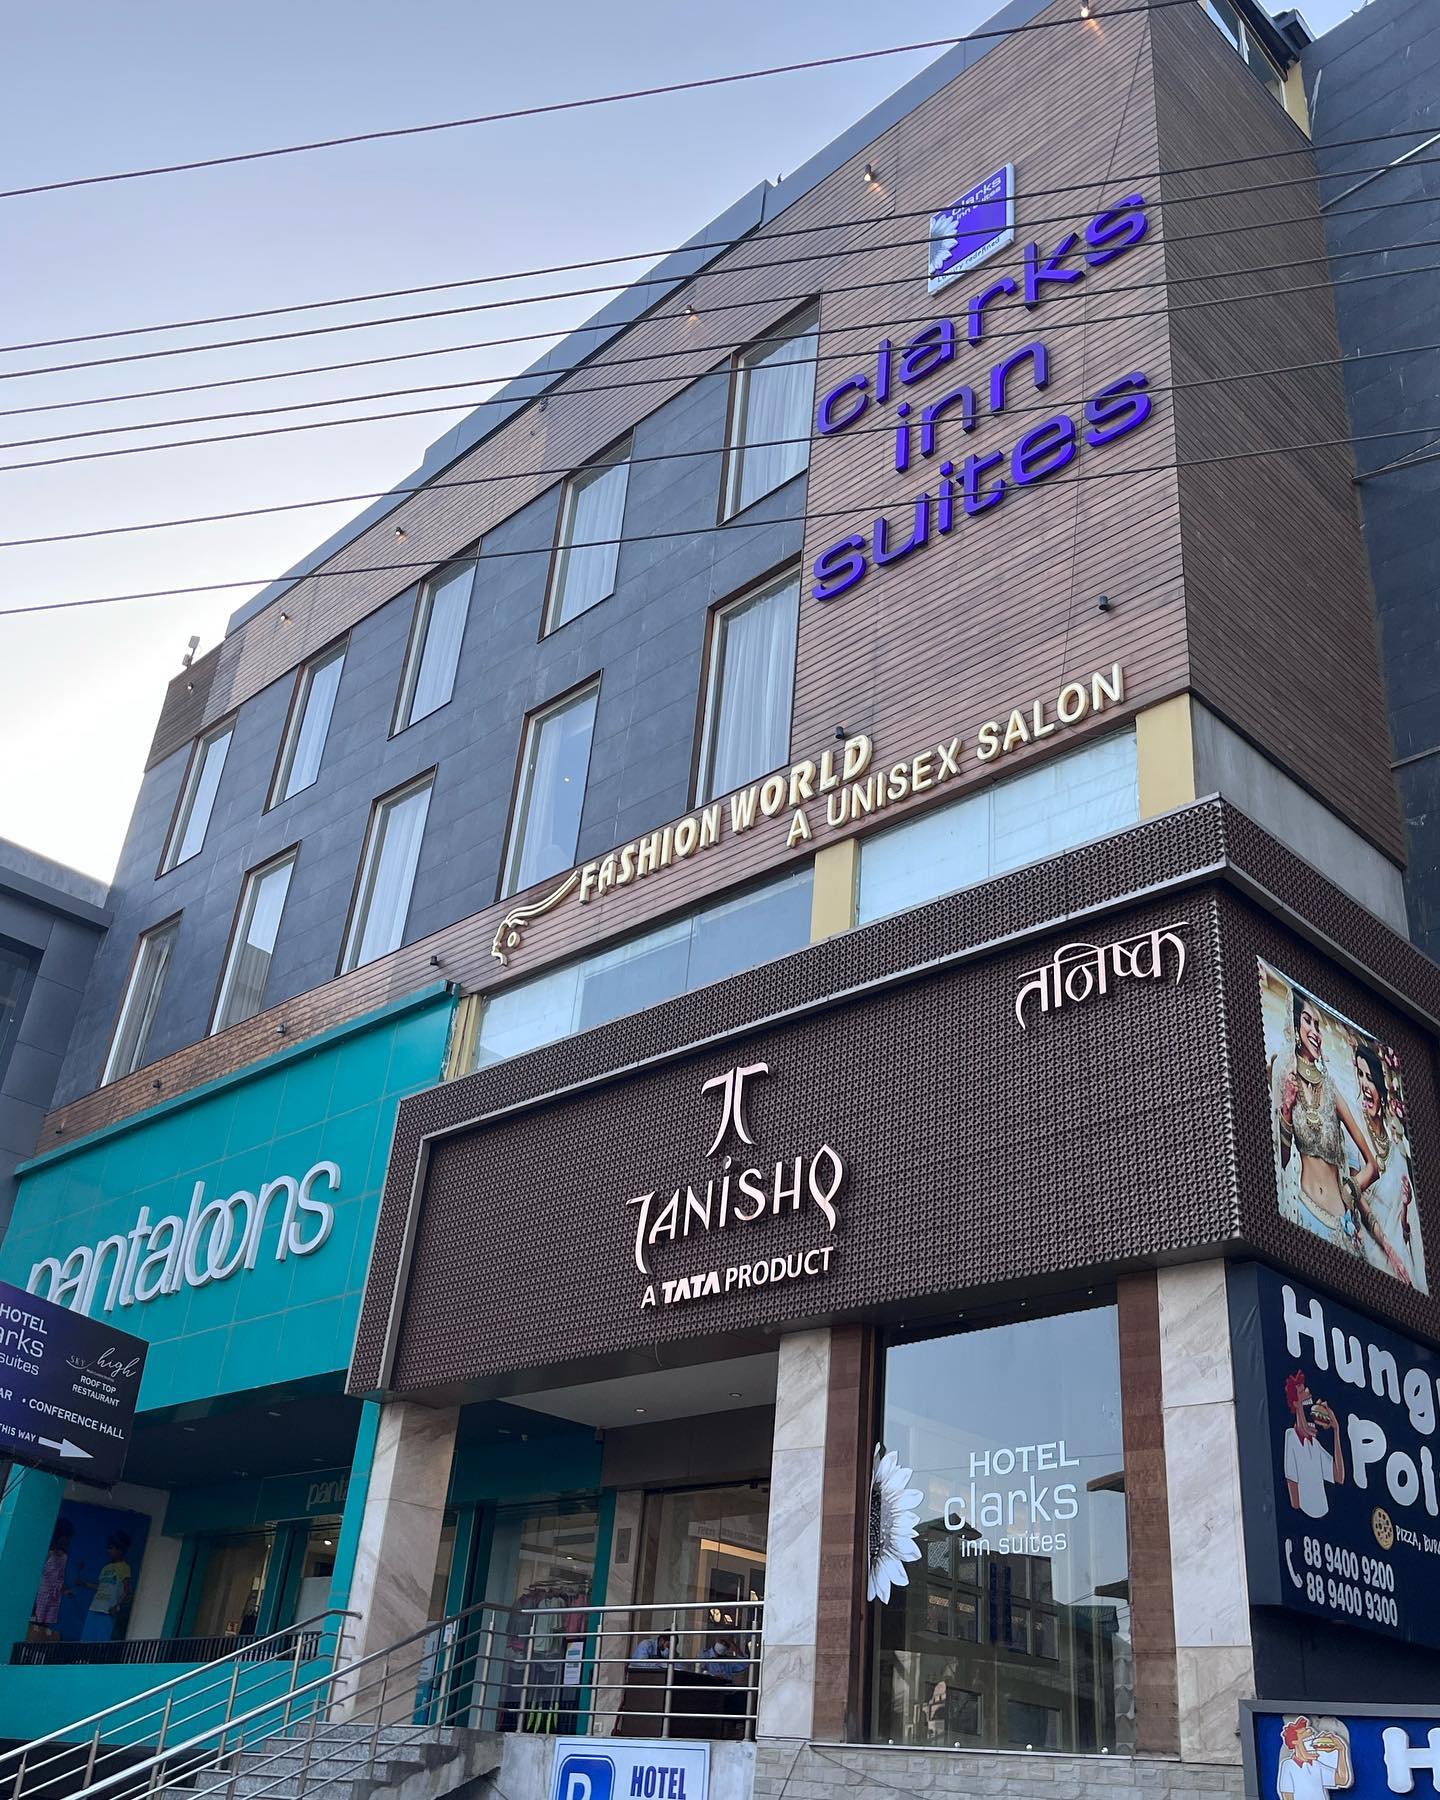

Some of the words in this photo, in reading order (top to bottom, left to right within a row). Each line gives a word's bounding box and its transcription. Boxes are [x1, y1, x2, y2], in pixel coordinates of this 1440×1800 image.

[817, 192, 1149, 435] clarks
[895, 341, 1050, 474] inn
[812, 370, 1152, 601] suites
[786, 808, 812, 848] A
[827, 736, 962, 828] UNISEX
[976, 662, 1125, 762] SALON
[579, 803, 722, 905] FASHION
[730, 734, 873, 834] WORLD
[641, 1285, 656, 1309] A
[662, 1271, 721, 1305] TATA
[725, 1246, 834, 1292] PRODUCT
[0, 1302, 48, 1335] HOTEL
[97, 1347, 140, 1378] high
[1281, 1284, 1440, 1435] Hung
[72, 1383, 120, 1407] RESTAURANT
[80, 1375, 101, 1389] ROOF
[102, 1383, 117, 1394] TOP
[18, 1429, 37, 1443] WAY
[29, 1398, 99, 1431] CONFERENCE
[99, 1423, 125, 1440] HALL
[969, 1440, 1080, 1478] HOTEL
[943, 1475, 1079, 1532] clarks
[961, 1534, 990, 1558] inn
[998, 1530, 1068, 1556] suites
[1395, 1524, 1421, 1551] PIZZA,
[1303, 1535, 1322, 1568] 88
[1324, 1542, 1359, 1581] 9400
[1361, 1555, 1394, 1593] 9200
[1306, 1571, 1325, 1605] 88
[1327, 1578, 1363, 1617] 9400
[1364, 1590, 1398, 1628] 9300
[630, 1765, 687, 1800] HOTEL
